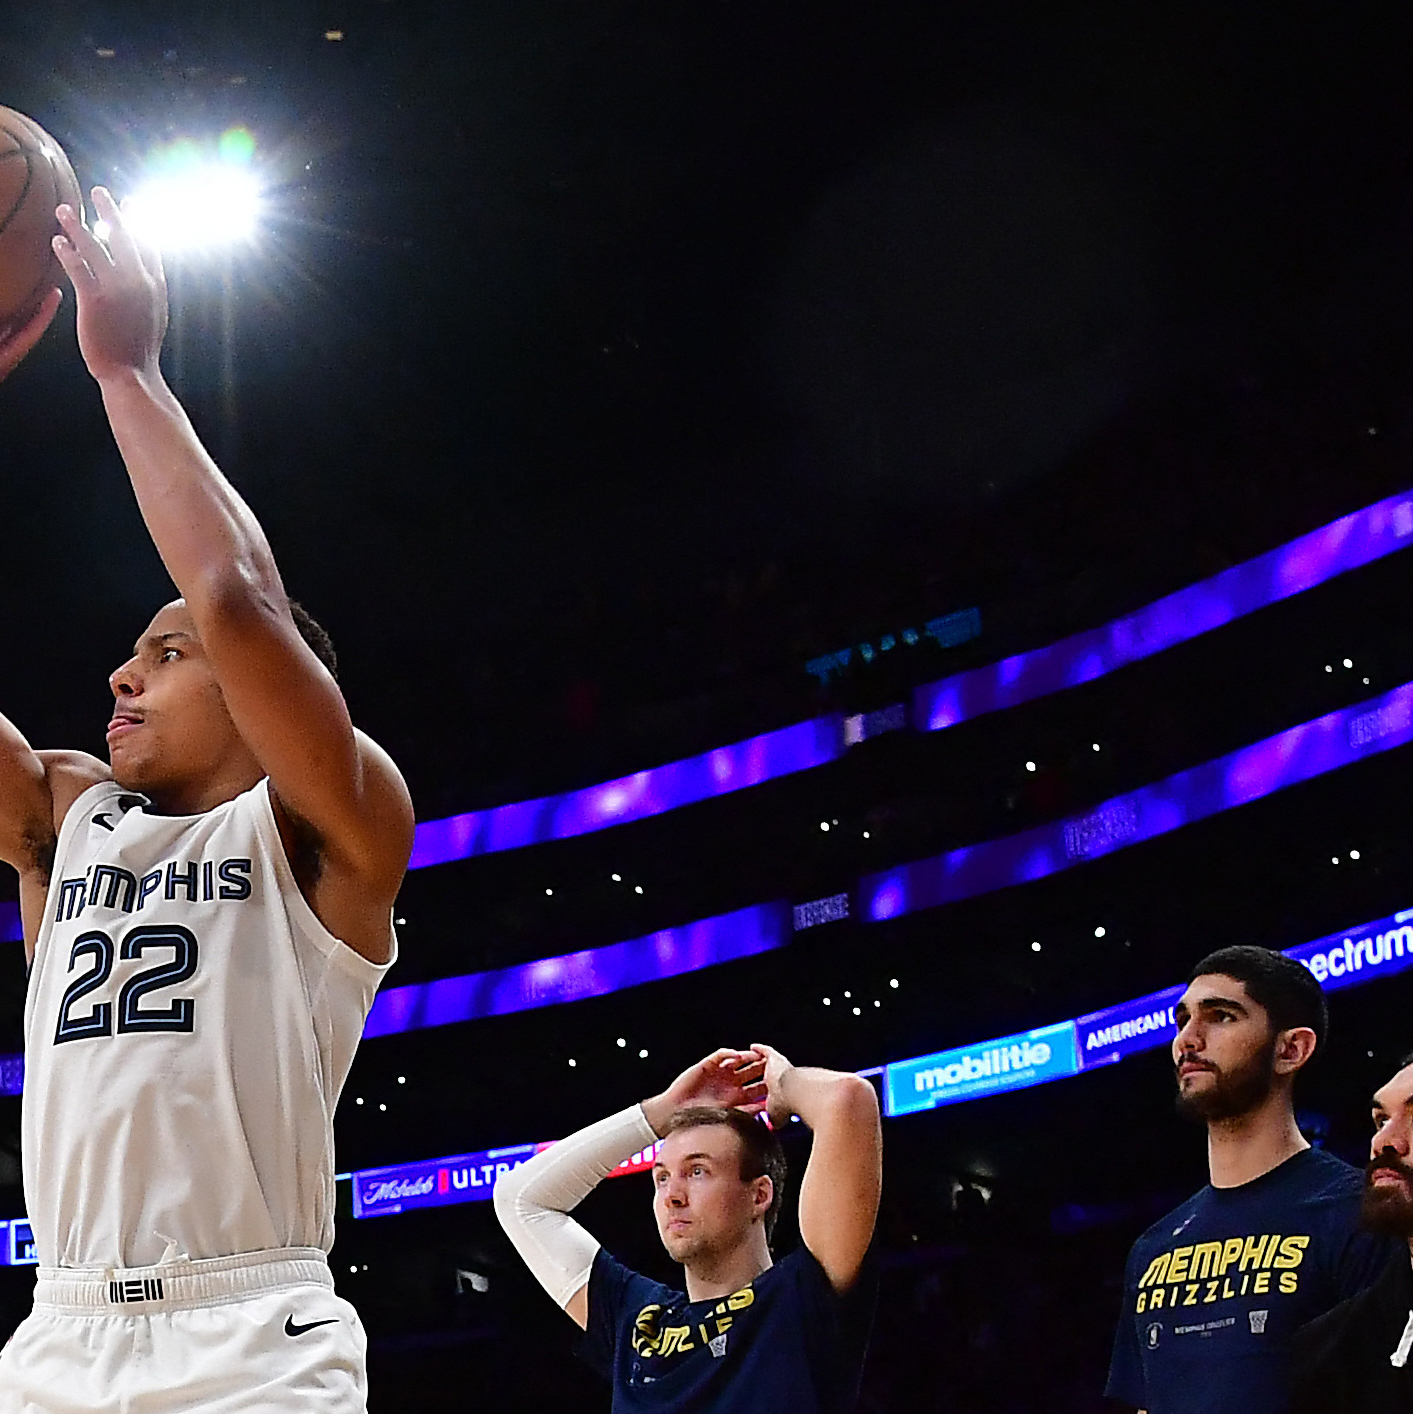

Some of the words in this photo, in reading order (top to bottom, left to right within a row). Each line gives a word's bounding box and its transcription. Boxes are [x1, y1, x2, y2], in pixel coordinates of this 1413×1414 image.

[53, 924, 199, 1046] 22
[1086, 1009, 1167, 1051] AMERICAN
[1137, 1234, 1311, 1289] MEMPHIS
[1135, 1271, 1299, 1314] GRIZZLIES
